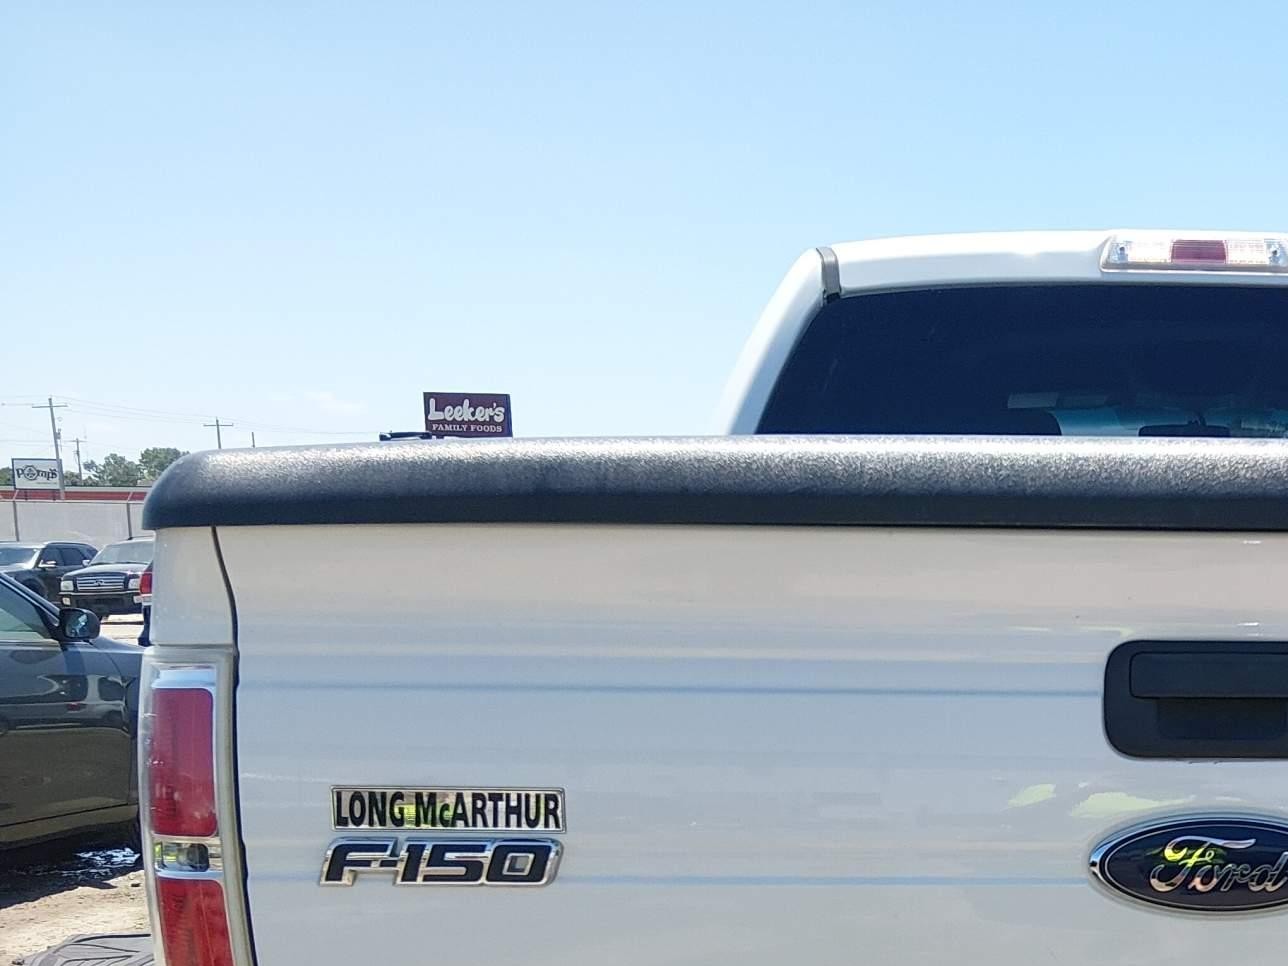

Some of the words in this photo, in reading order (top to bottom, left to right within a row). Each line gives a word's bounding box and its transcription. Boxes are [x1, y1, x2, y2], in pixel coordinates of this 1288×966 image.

[428, 398, 505, 422] Leeker's
[432, 423, 468, 432] FAMILY
[470, 424, 503, 433] FOODS
[336, 791, 405, 828] LONG
[414, 792, 561, 829] McARTHUR
[319, 836, 564, 887] F-150
